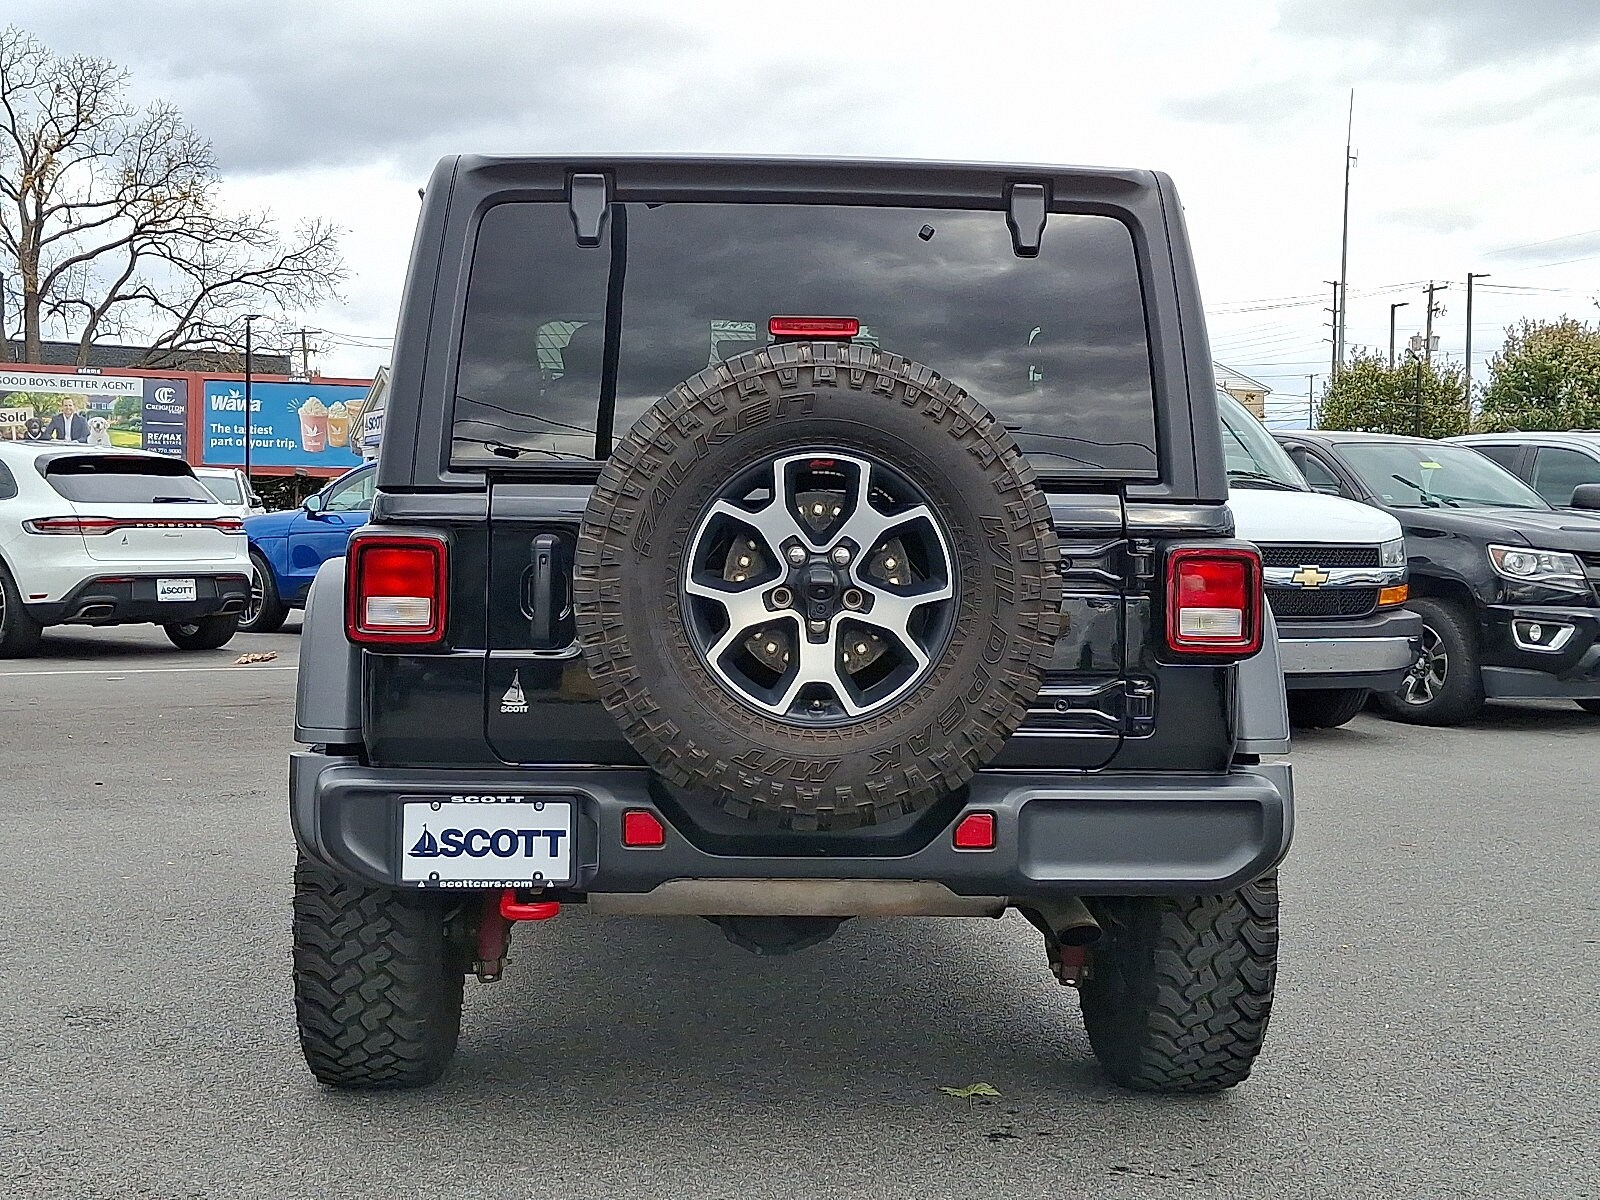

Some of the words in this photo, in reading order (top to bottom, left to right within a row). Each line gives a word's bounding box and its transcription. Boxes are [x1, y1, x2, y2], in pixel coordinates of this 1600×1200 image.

[29, 377, 58, 388] BOYS.
[60, 379, 98, 389] BETTER
[101, 381, 135, 391] AGENT.
[0, 412, 27, 423] Sold
[210, 423, 231, 434] The
[233, 424, 273, 435] tatiest
[210, 437, 233, 448] part
[249, 438, 274, 449] your
[276, 437, 298, 451] trip.
[166, 586, 194, 594] SCOTT
[500, 705, 529, 713] SCOTT
[450, 795, 525, 804] SCOTT
[438, 828, 567, 858] SCOTT
[439, 880, 533, 888] scottcars.com
